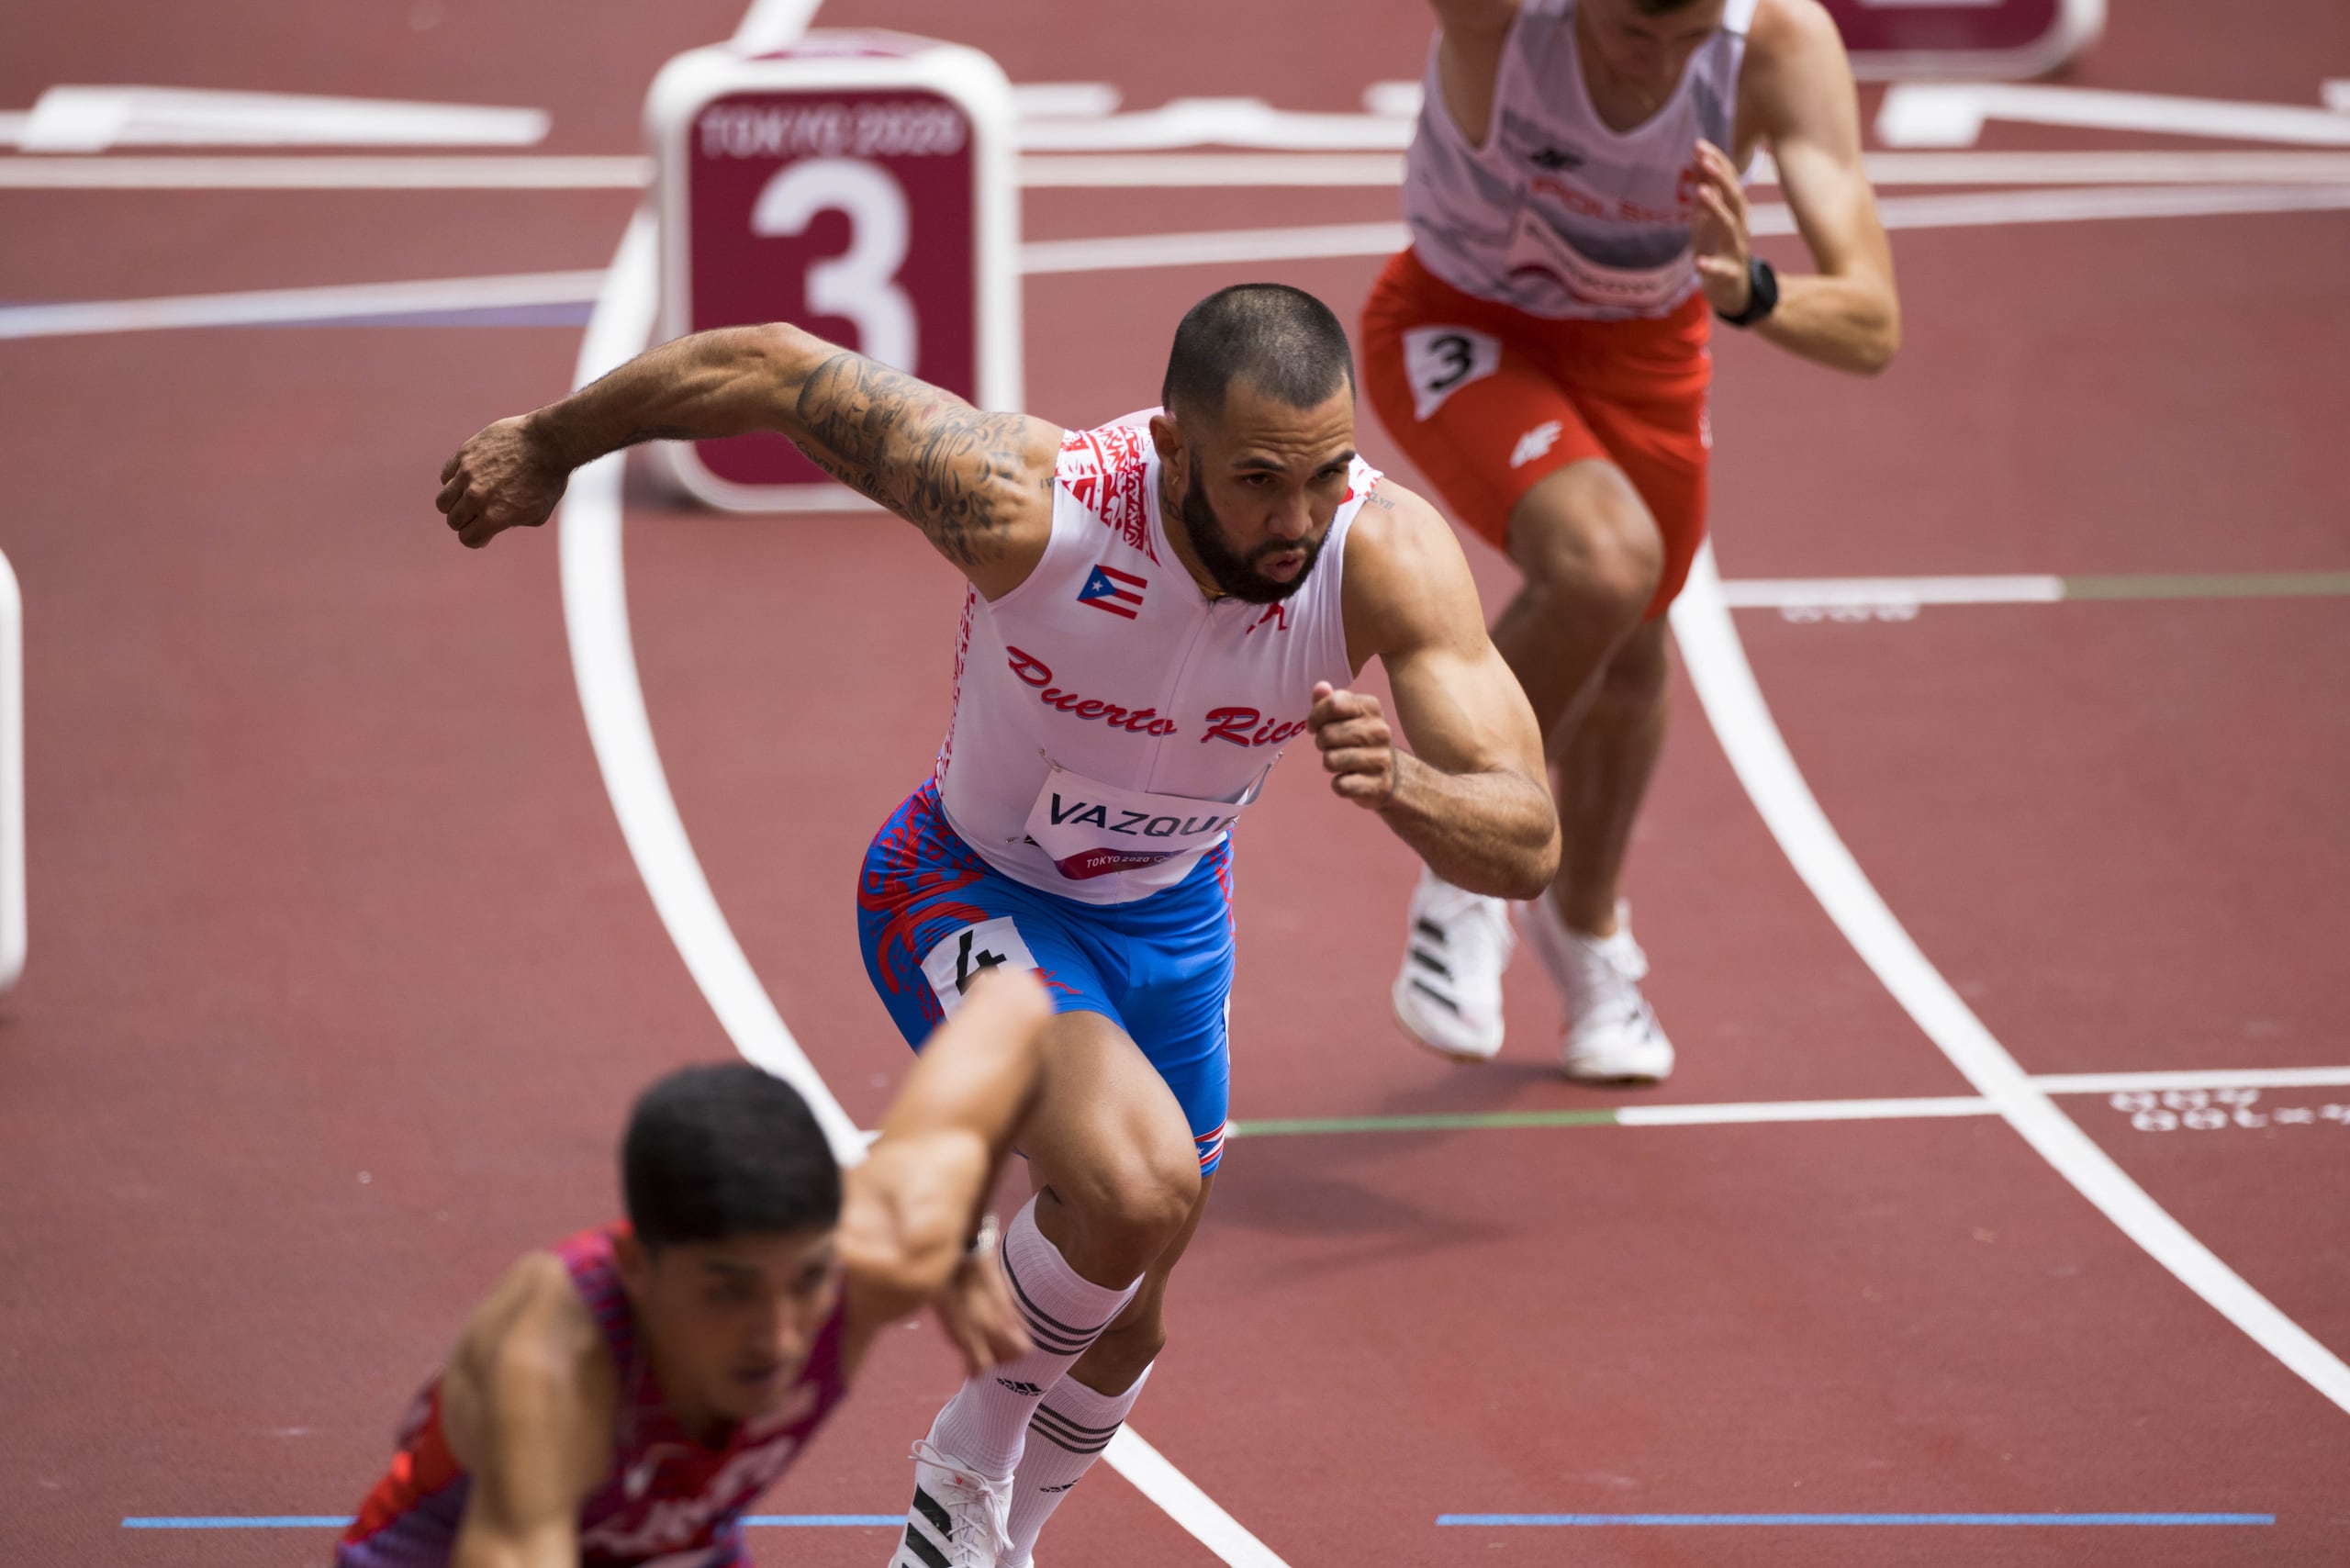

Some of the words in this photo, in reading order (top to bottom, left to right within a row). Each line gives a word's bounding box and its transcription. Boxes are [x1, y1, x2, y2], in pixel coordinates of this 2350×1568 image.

[703, 106, 844, 155] TOKYO
[854, 105, 962, 154] 2020
[752, 158, 916, 376] 3
[1427, 334, 1474, 392] 3
[1006, 644, 1177, 735] Puerto
[1200, 705, 1310, 748] Rico
[1086, 855, 1121, 869] TOKYO
[956, 929, 1007, 996] 4
